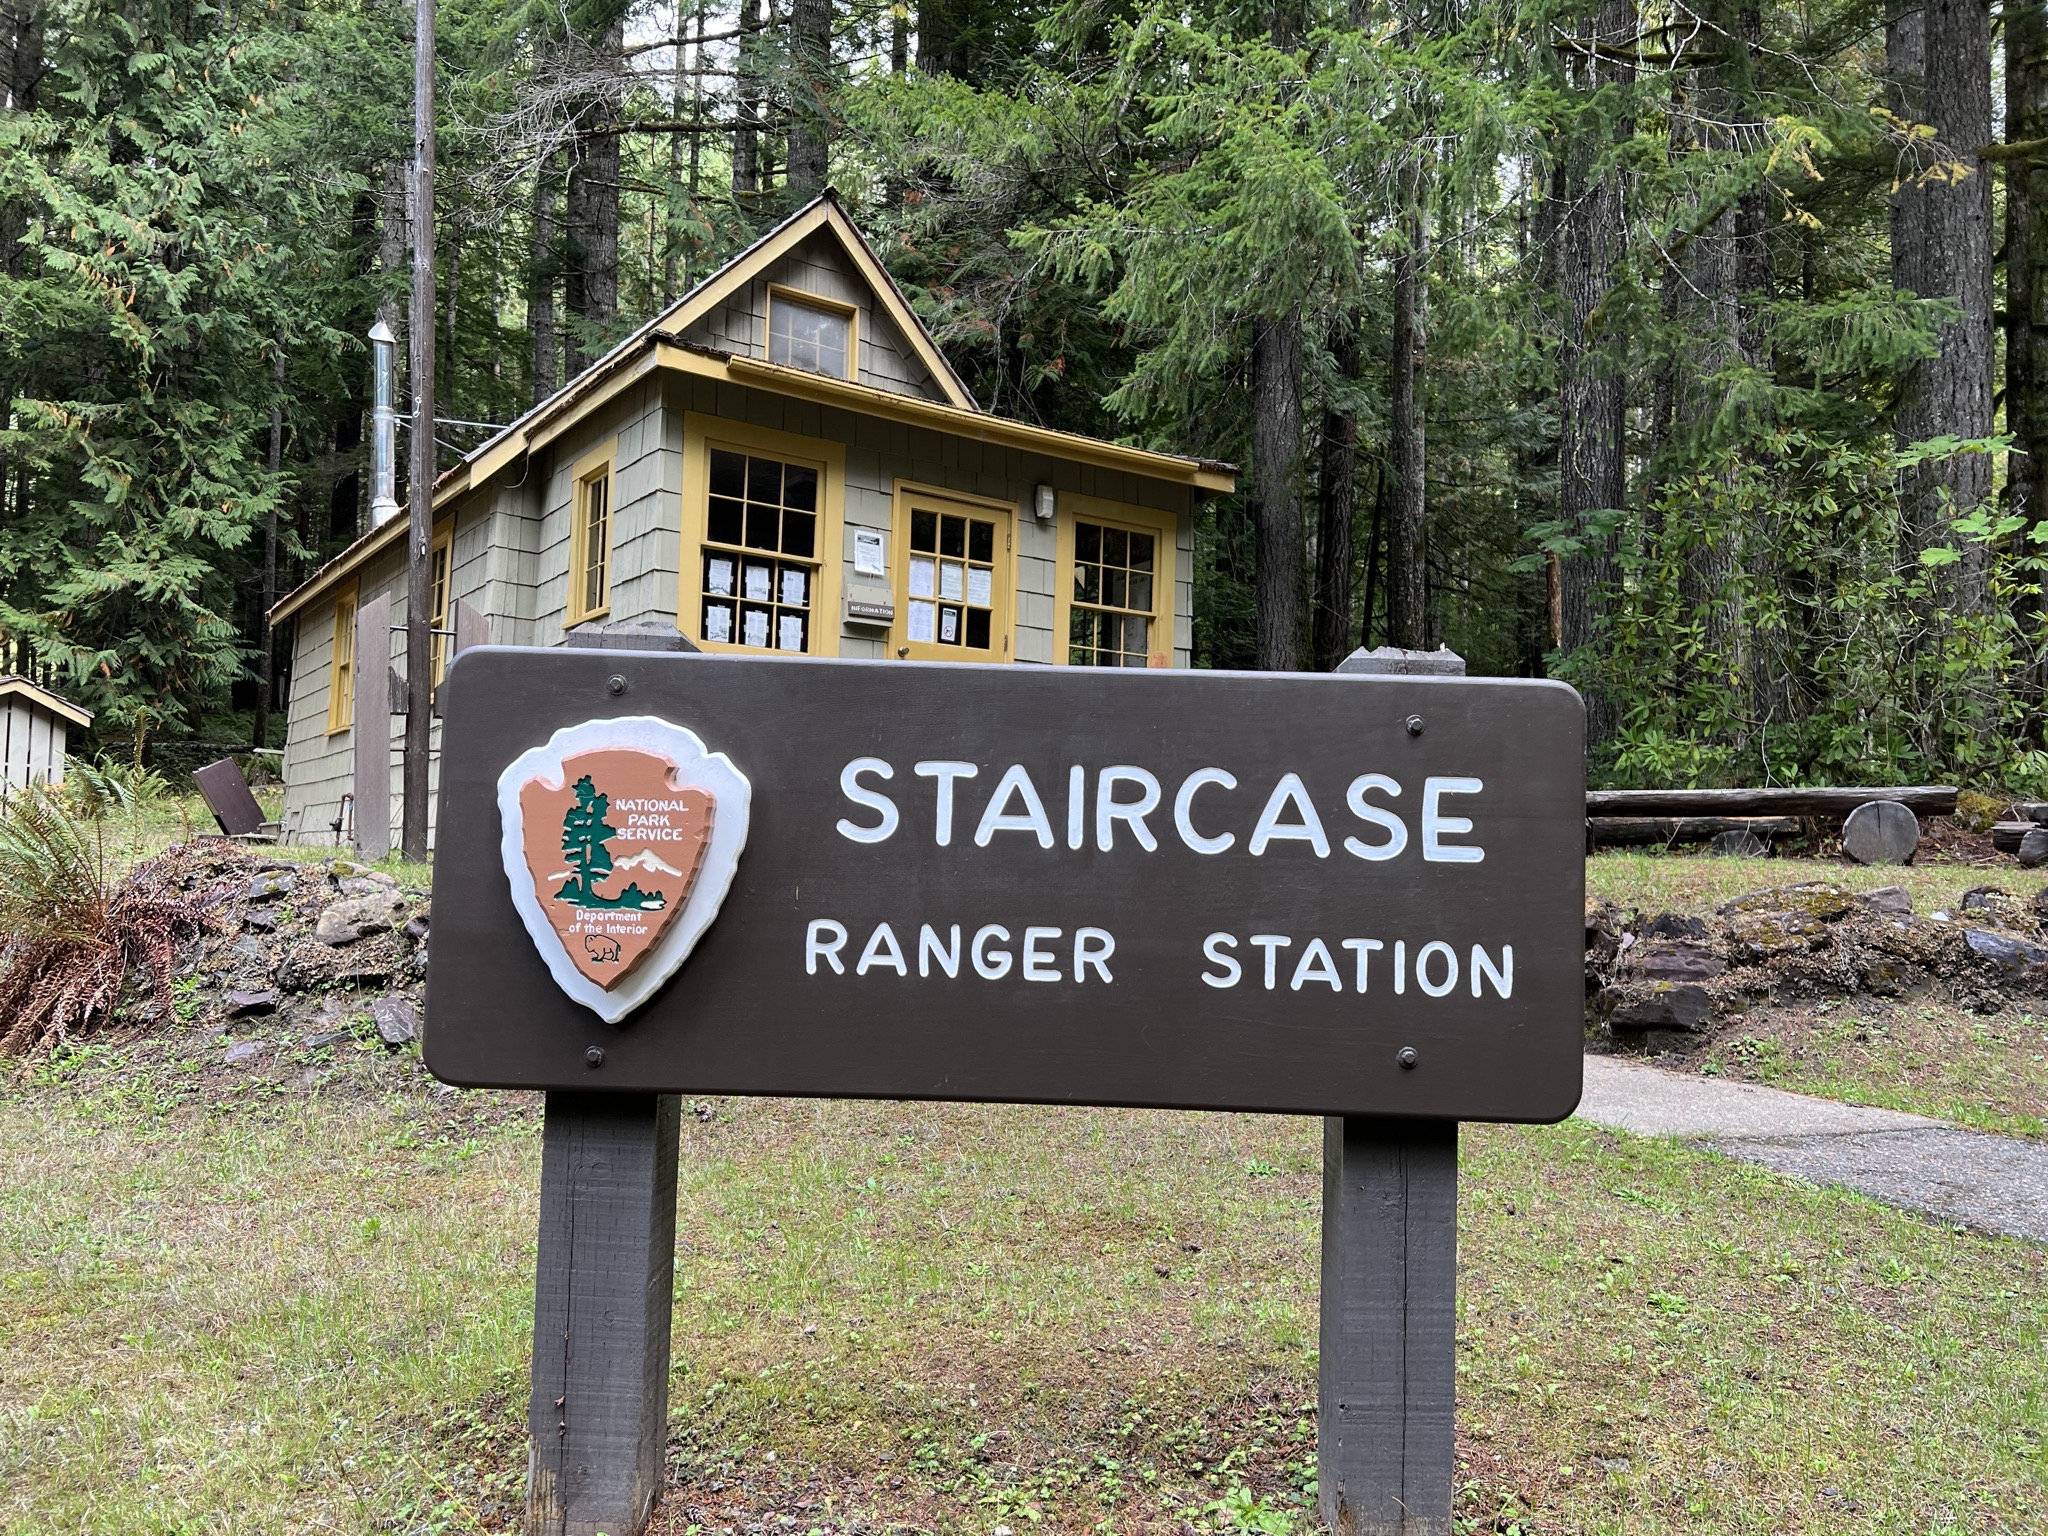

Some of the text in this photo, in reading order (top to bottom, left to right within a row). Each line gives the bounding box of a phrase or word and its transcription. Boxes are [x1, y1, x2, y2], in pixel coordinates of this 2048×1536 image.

[851, 605, 893, 615] INFORMATION
[616, 799, 689, 812] NATIONAL
[837, 757, 1486, 863] STAIRCASE
[627, 814, 670, 826] PARK
[616, 828, 683, 841] SERVICE
[576, 909, 642, 922] Department
[568, 923, 648, 935] of the Interior
[806, 919, 1514, 999] RANGER STATION
